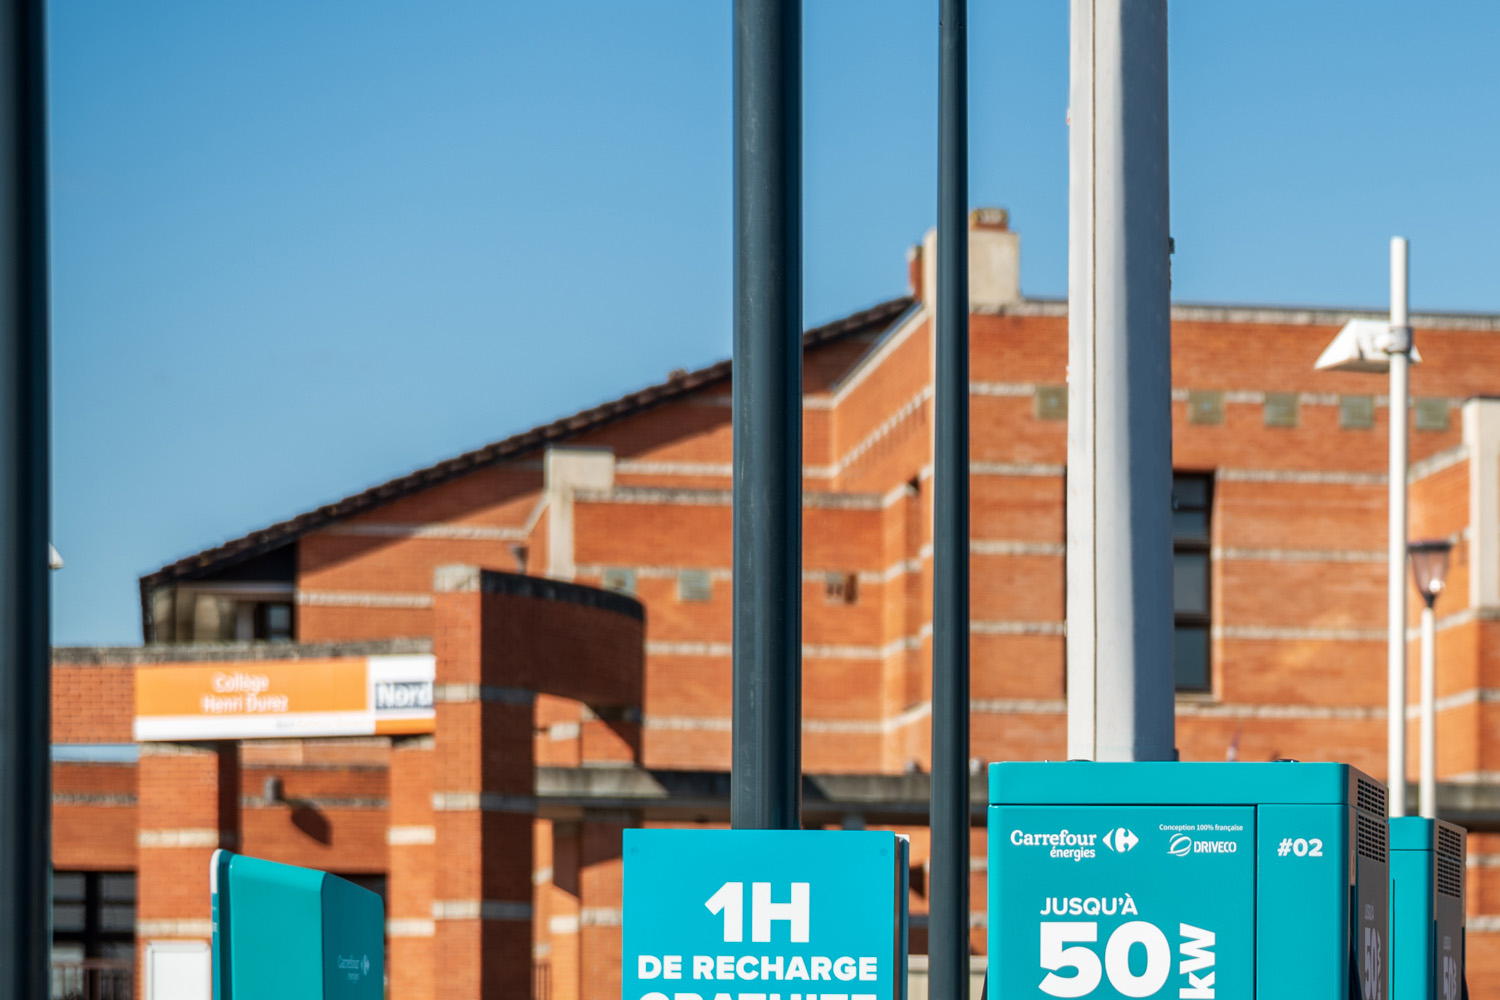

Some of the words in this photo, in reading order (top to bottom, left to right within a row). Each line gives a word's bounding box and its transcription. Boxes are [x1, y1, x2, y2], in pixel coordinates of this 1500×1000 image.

[203, 694, 243, 714] Henri
[378, 684, 433, 708] Nord
[1010, 829, 1097, 846] Carrefour
[1159, 823, 1196, 832] Conception
[1215, 823, 1244, 832] française
[1050, 846, 1096, 862] énergies
[1193, 841, 1237, 853] DRIVECO
[1277, 838, 1324, 857] #02
[704, 881, 811, 943] 1H
[637, 955, 682, 981] DE
[693, 955, 878, 981] RECHARGE
[1038, 920, 1172, 999] 50
[1179, 922, 1216, 1000] kW
